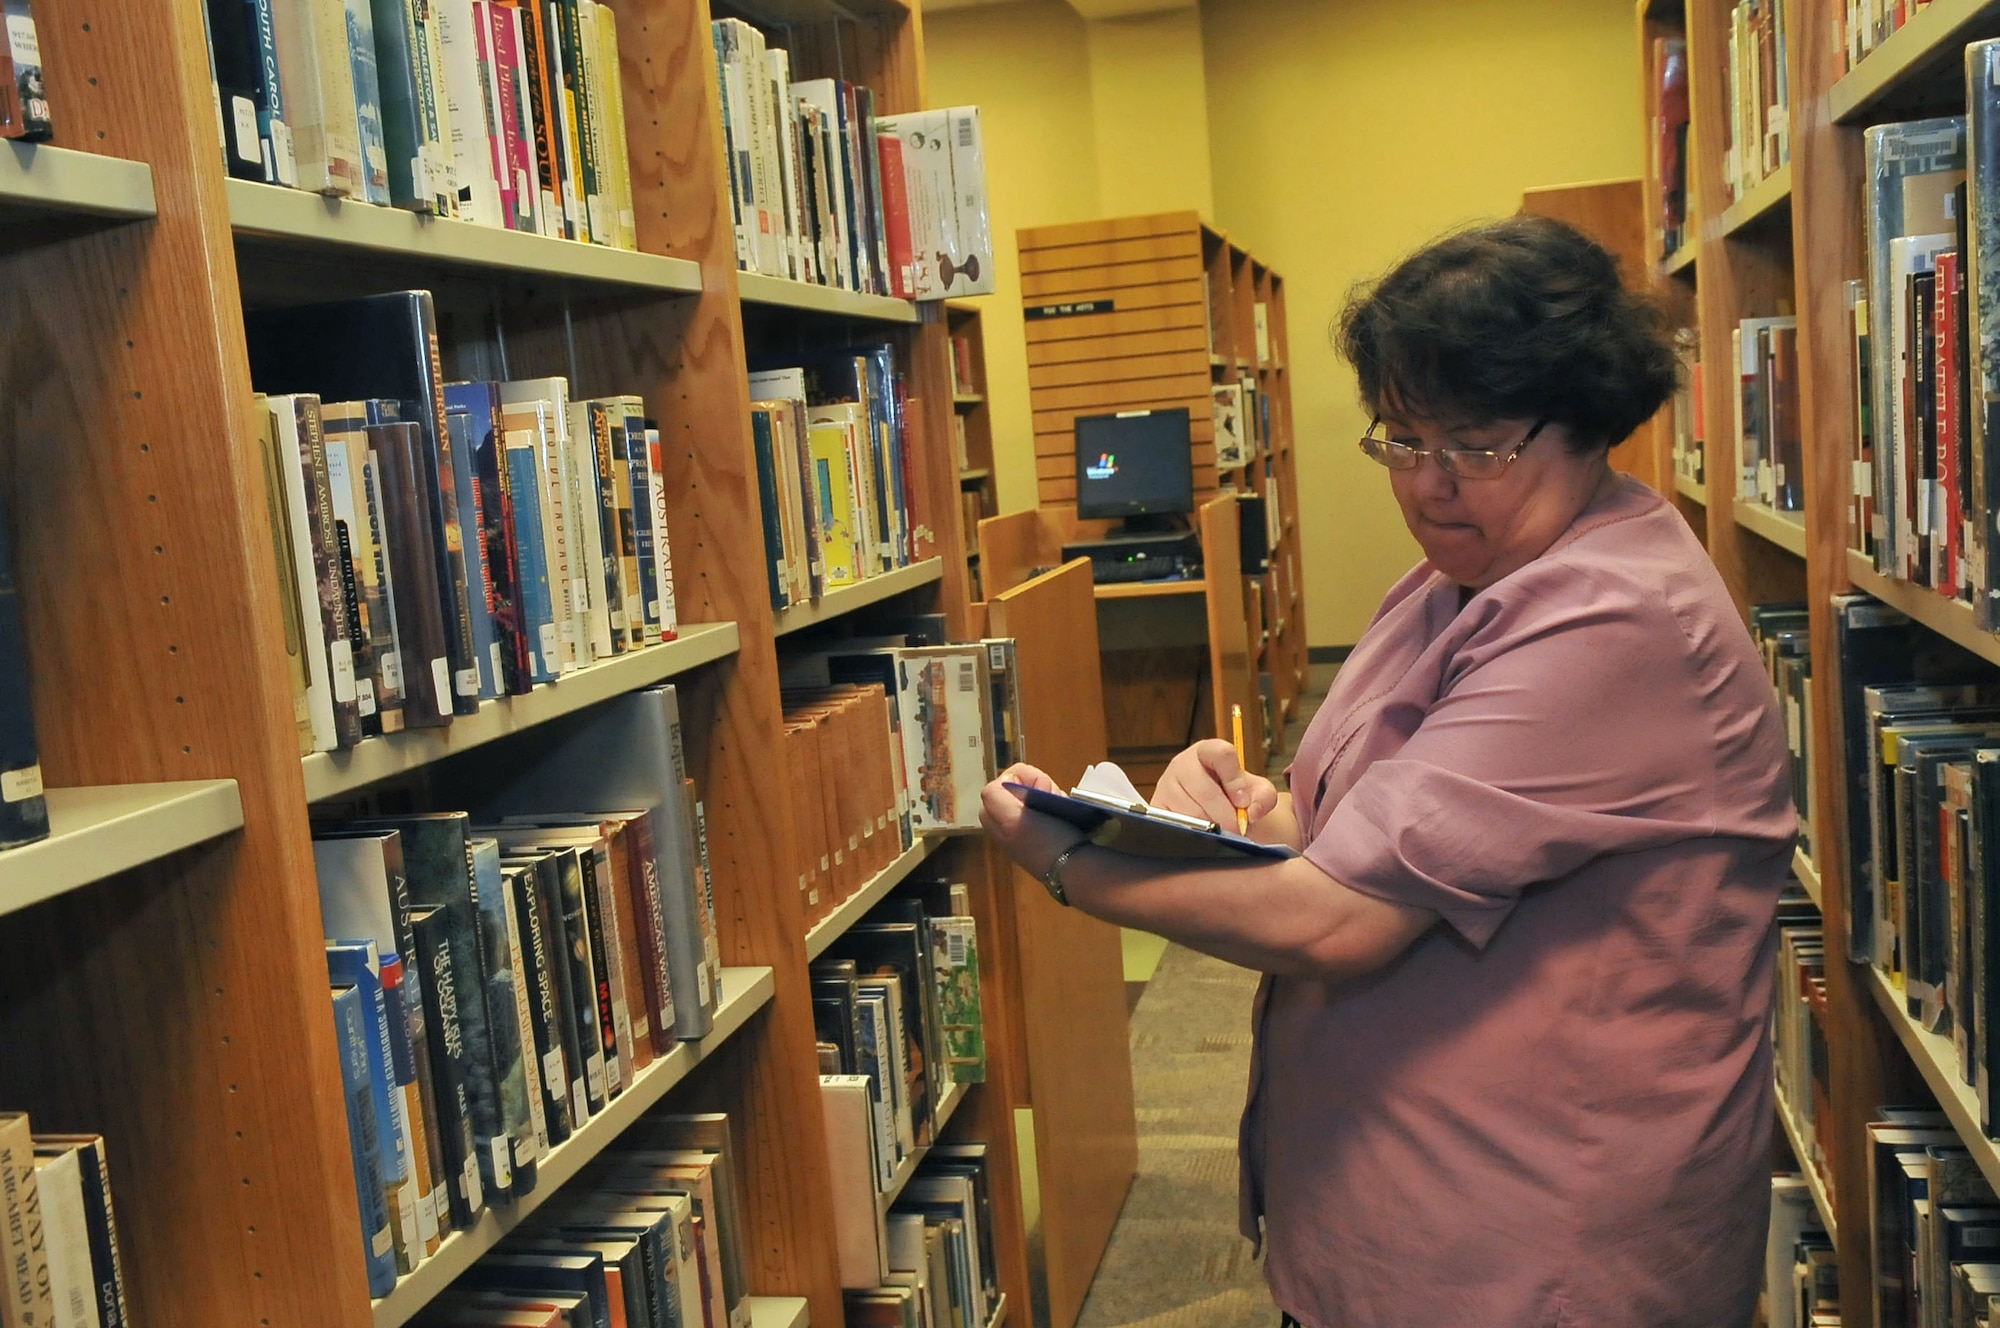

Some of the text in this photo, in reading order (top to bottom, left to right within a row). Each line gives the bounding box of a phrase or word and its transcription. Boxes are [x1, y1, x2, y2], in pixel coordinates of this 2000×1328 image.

[433, 26, 447, 94] GEORGIA
[569, 6, 580, 46] STATE
[417, 29, 434, 101] CHARLESTON
[493, 14, 503, 56] Best
[498, 63, 513, 124] Places
[508, 130, 516, 147] to
[574, 49, 585, 93] PARKS
[580, 107, 593, 168] MIDWEST
[1936, 265, 1944, 323] THE
[429, 332, 450, 452] HILLERMAN
[1936, 333, 1947, 435] BATTLE
[307, 410, 322, 467] STEPHEN
[315, 470, 324, 478] E
[495, 437, 504, 470] NATIONAL
[594, 409, 608, 478] America
[317, 480, 334, 548] AMBROSE
[363, 462, 382, 545] OREGON
[498, 470, 506, 491] PARKS
[478, 527, 488, 560] GREAT
[654, 481, 675, 594] AUSTRALIA
[339, 528, 348, 549] THE
[345, 559, 358, 625] JOURNALS
[460, 613, 473, 660] HILLERMAN
[670, 722, 684, 785] BEATLES
[464, 839, 478, 904] Hawaii
[645, 860, 667, 954] AMERICAN
[395, 874, 423, 1034] AUSTRALIA
[524, 873, 551, 1023] EXPLORING SPACE
[399, 988, 416, 1075] EXPLORING
[433, 954, 452, 1056] OF OCEANIA
[438, 938, 463, 1059] THE HAPPY ISLES
[374, 987, 382, 1002] IN
[378, 1014, 396, 1080] SUNBURNED
[387, 1082, 401, 1130] COUNTRY
[876, 1017, 888, 1092] ANCIENT
[457, 1083, 467, 1117] PAUL
[1, 1148, 32, 1306] MARGARET MEAD
[19, 1166, 52, 1299] A WAY OF
